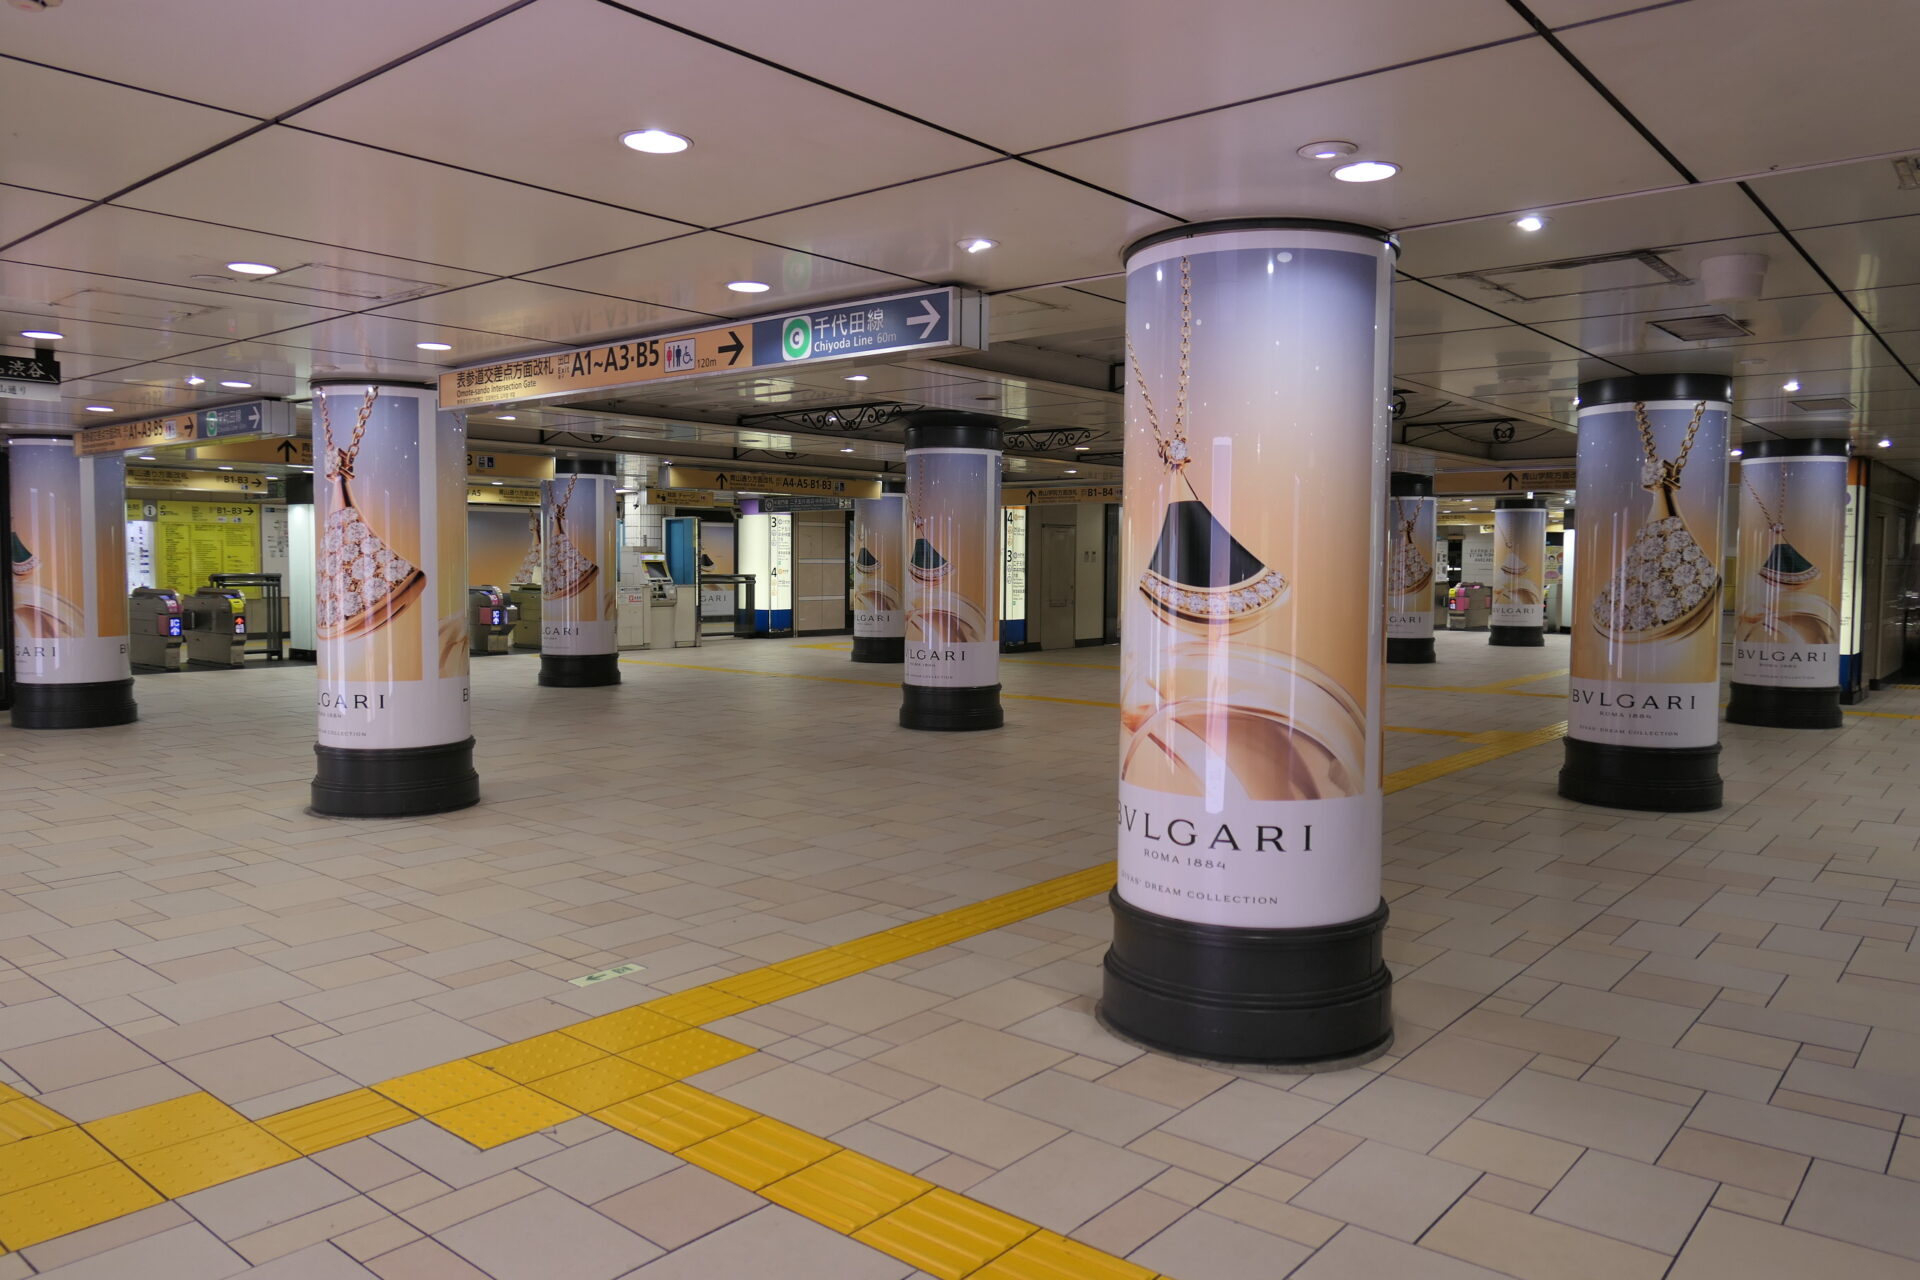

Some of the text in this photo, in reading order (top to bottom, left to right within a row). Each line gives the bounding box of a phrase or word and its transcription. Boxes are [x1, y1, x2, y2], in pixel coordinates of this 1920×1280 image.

[814, 308, 884, 339] 千代田線
[814, 332, 897, 353] Chiyoda Line 60m
[558, 354, 570, 366] 出口
[697, 358, 717, 369] 120m
[457, 356, 554, 389] 表参道交差点方面改札
[557, 365, 570, 375] Exit
[456, 386, 490, 398] Omote-sando
[491, 382, 522, 393] Intersection
[523, 379, 537, 388] Gate
[771, 517, 777, 528] 3
[1007, 512, 1013, 524] 4
[1007, 550, 1013, 562] 3
[771, 567, 777, 577] 4
[542, 626, 579, 636] GARI
[1738, 649, 1826, 662] BVLGARI
[317, 692, 385, 709] GARI
[1572, 688, 1696, 710] BVLGARI
[1144, 848, 1226, 870] ROMA 1884
[1145, 881, 1182, 897] DREAM
[1187, 890, 1279, 905] COLLECTION
